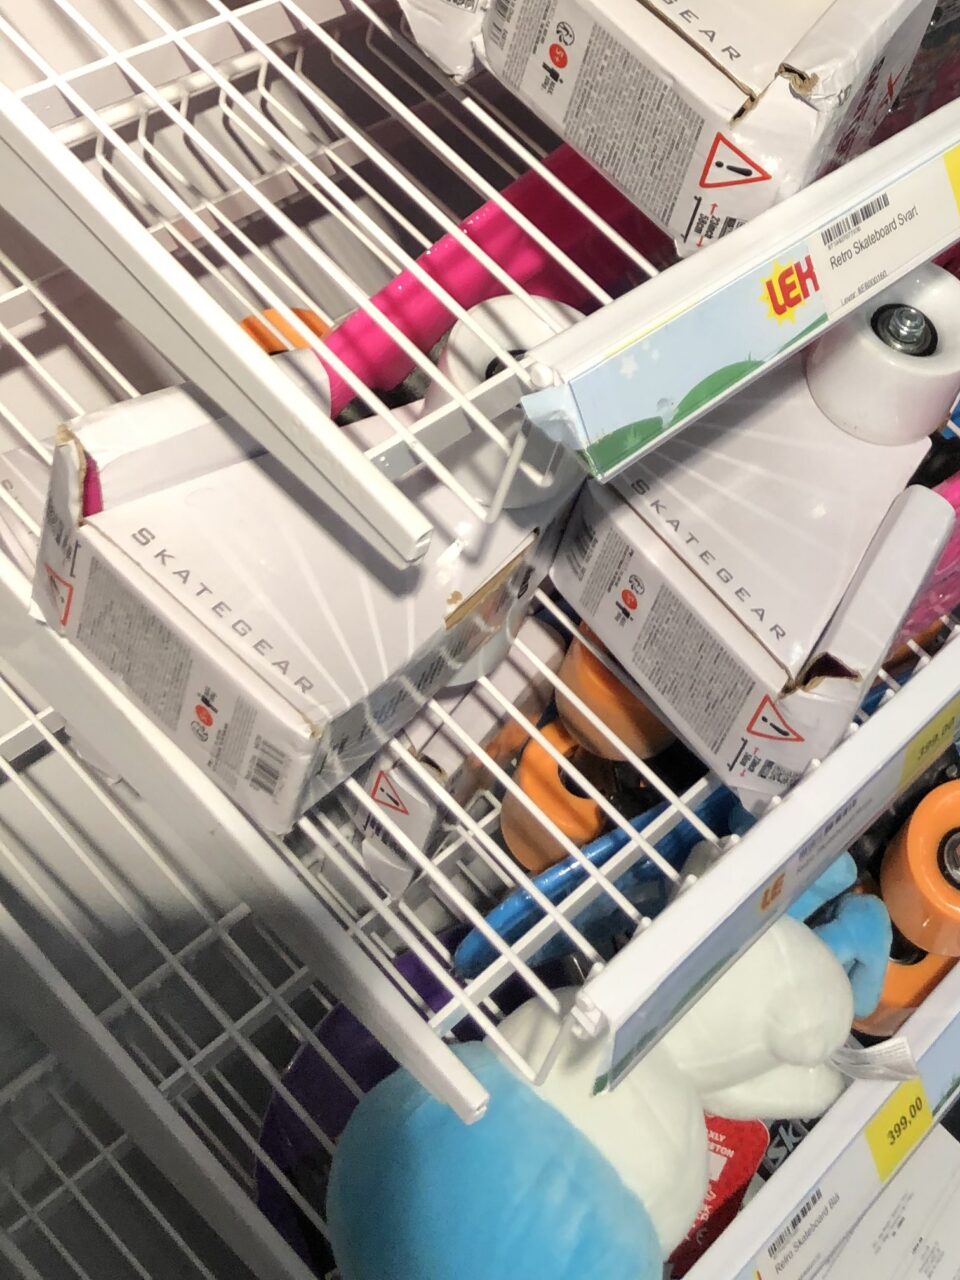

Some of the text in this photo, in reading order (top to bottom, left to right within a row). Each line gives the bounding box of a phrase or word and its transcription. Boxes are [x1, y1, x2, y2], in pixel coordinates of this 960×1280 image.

[829, 248, 853, 270] Retro
[852, 218, 898, 255] Skateboard
[897, 204, 919, 226] Svart
[131, 527, 315, 695] SKATEGEAR
[630, 478, 788, 642] SKATEGEAR
[886, 1096, 923, 1146] 399,00
